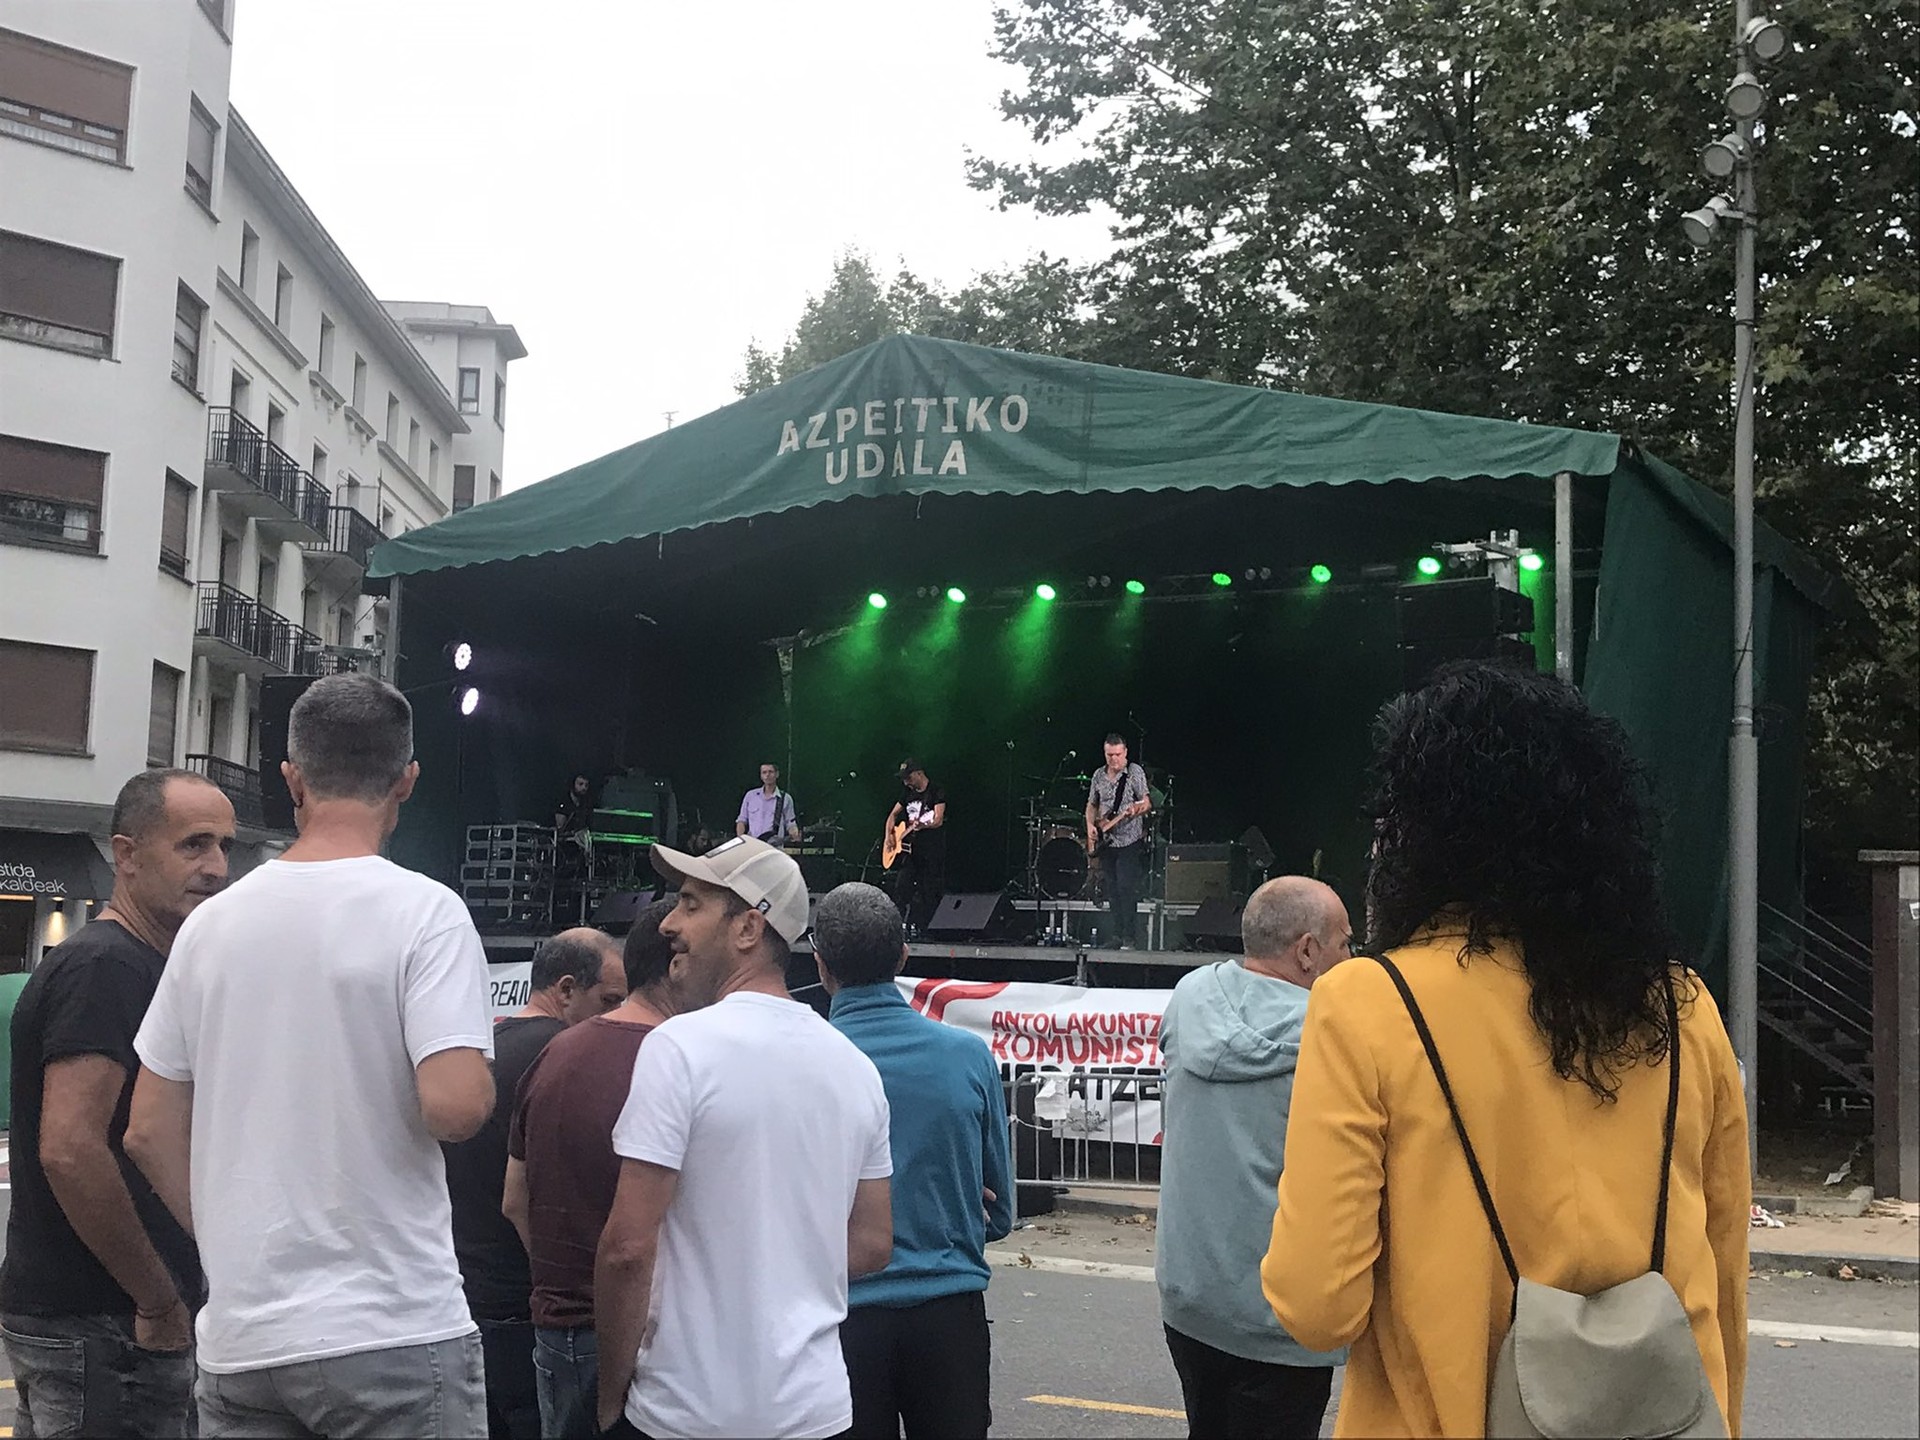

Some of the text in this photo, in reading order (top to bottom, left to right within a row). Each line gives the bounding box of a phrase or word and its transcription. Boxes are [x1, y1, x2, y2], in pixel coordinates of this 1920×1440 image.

[776, 394, 1029, 456] AZPEITIKO
[825, 439, 967, 485] UDALA
[991, 1032, 1167, 1066] KOMUNIST
